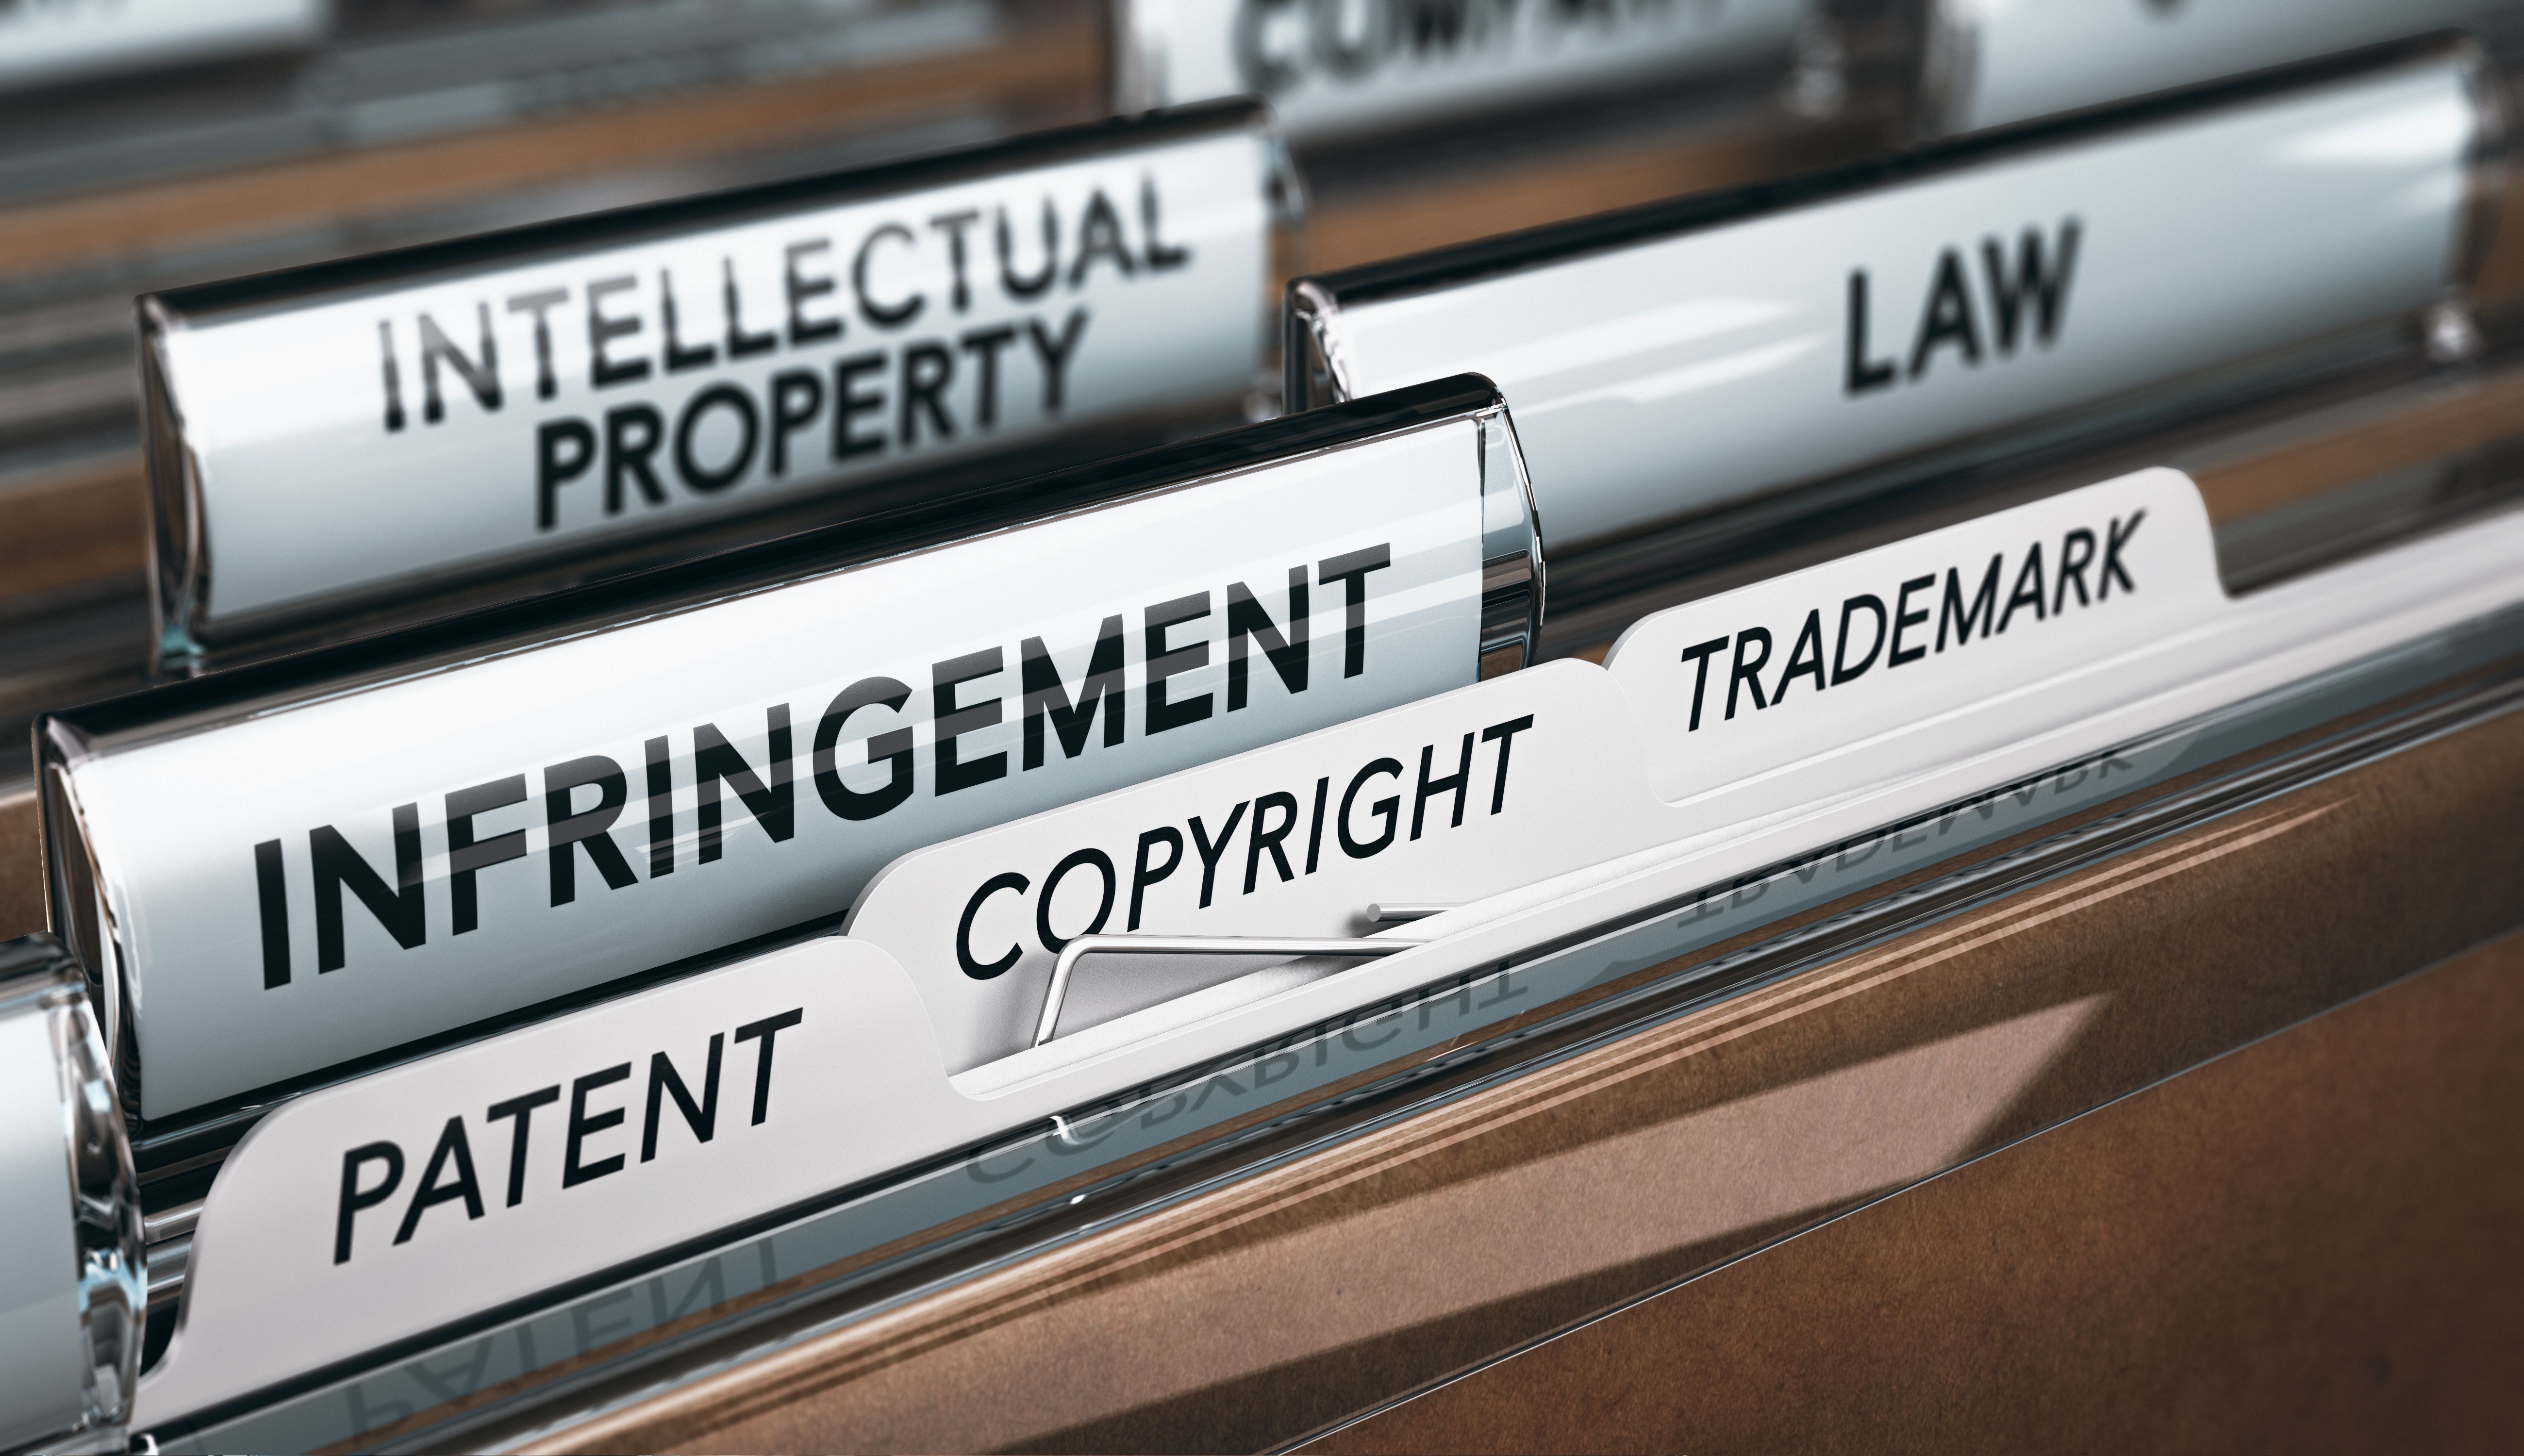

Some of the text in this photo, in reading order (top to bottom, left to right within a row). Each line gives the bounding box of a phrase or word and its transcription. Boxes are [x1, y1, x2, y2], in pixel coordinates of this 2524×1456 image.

[379, 171, 1192, 434] INTELLECTUAL
[536, 308, 1091, 531] PROPERTY
[1843, 221, 2082, 399] LAW
[1681, 510, 2145, 732] TRADEMARK
[254, 543, 1391, 992] INFRINGEMENT
[956, 714, 1534, 980] COPYRIGHT
[333, 1007, 803, 1266] PATENT
